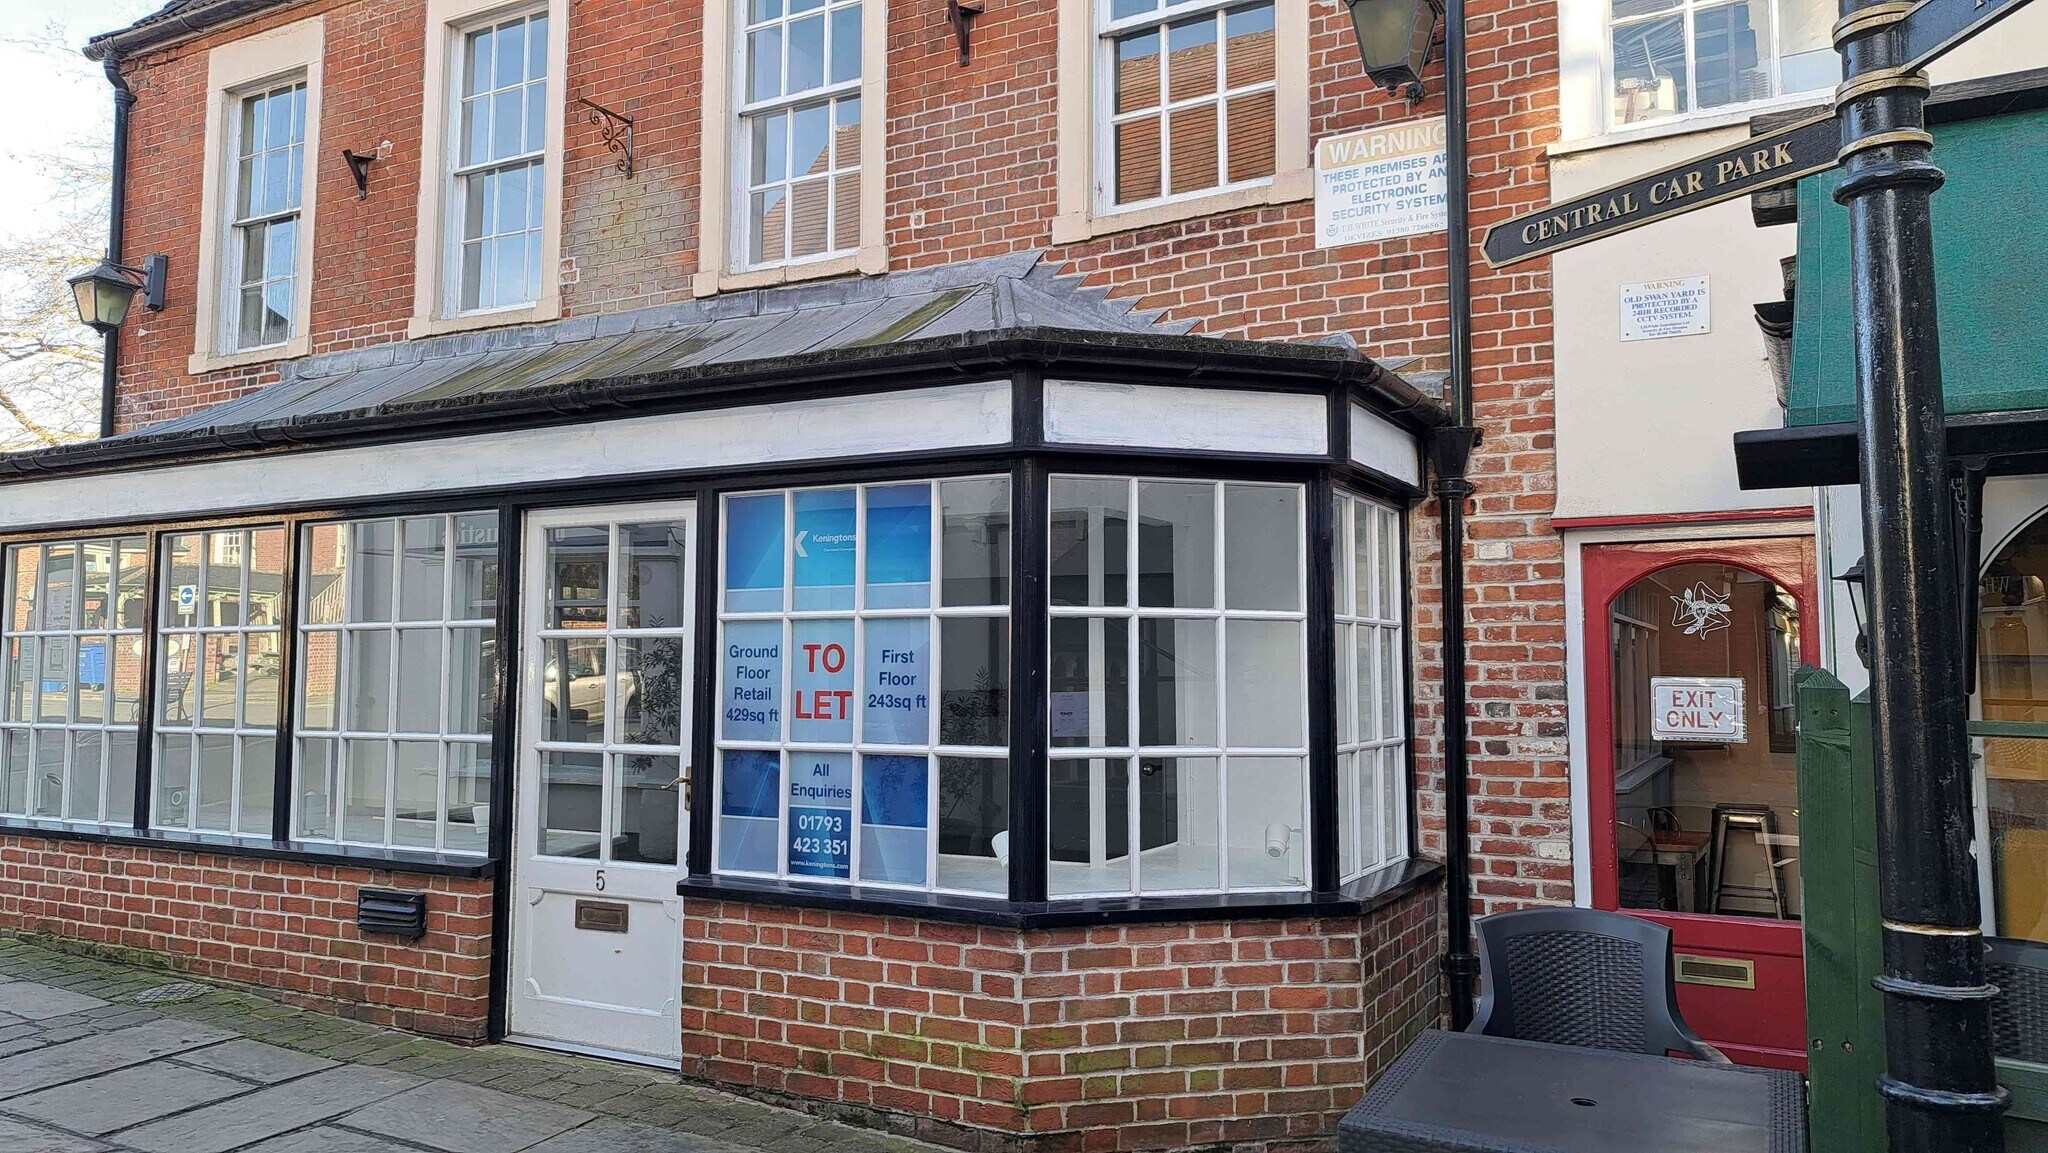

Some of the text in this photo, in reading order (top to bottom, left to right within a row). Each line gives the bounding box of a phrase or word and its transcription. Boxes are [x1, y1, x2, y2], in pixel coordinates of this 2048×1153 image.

[1328, 124, 1447, 164] WARNING
[1323, 153, 1449, 184] THESE PREMISES AR
[1332, 174, 1401, 195] PROTECTED
[1406, 172, 1422, 183] BY
[1521, 140, 1794, 244] CENTRAL CAR PARK
[1351, 183, 1428, 205] ELECTRONIC
[1332, 202, 1391, 221] SECURITY
[1381, 216, 1407, 226] Security
[1408, 214, 1414, 222] &
[1416, 212, 1429, 221] Fire
[1430, 210, 1447, 220] Syste
[1344, 230, 1383, 242] DEVIZES
[1643, 280, 1686, 291] WARNING
[1624, 288, 1706, 304] OLD SWAN YARD IS
[1632, 299, 1679, 310] PROTECTED
[1680, 297, 1691, 305] BY
[1632, 303, 1698, 317] 24HR RECORDED
[1636, 315, 1659, 323] CCTV
[812, 533, 856, 544] Keningtons
[729, 644, 779, 659] Ground
[802, 643, 846, 674] TO
[882, 649, 915, 664] First
[736, 666, 771, 680] Floor
[879, 671, 917, 686] Floor
[734, 686, 772, 701] Retail
[1672, 690, 1717, 708] EXIT
[795, 690, 853, 720] LET
[868, 693, 927, 712] 243sq ft
[725, 708, 779, 725] 429sq ft
[1666, 710, 1724, 729] ONLY
[812, 763, 830, 777] All
[791, 783, 852, 800] Enquiries
[798, 814, 843, 833] 01793
[793, 836, 848, 856] 423 351
[790, 860, 849, 870] www.keningtons.com
[595, 869, 606, 892] 5
